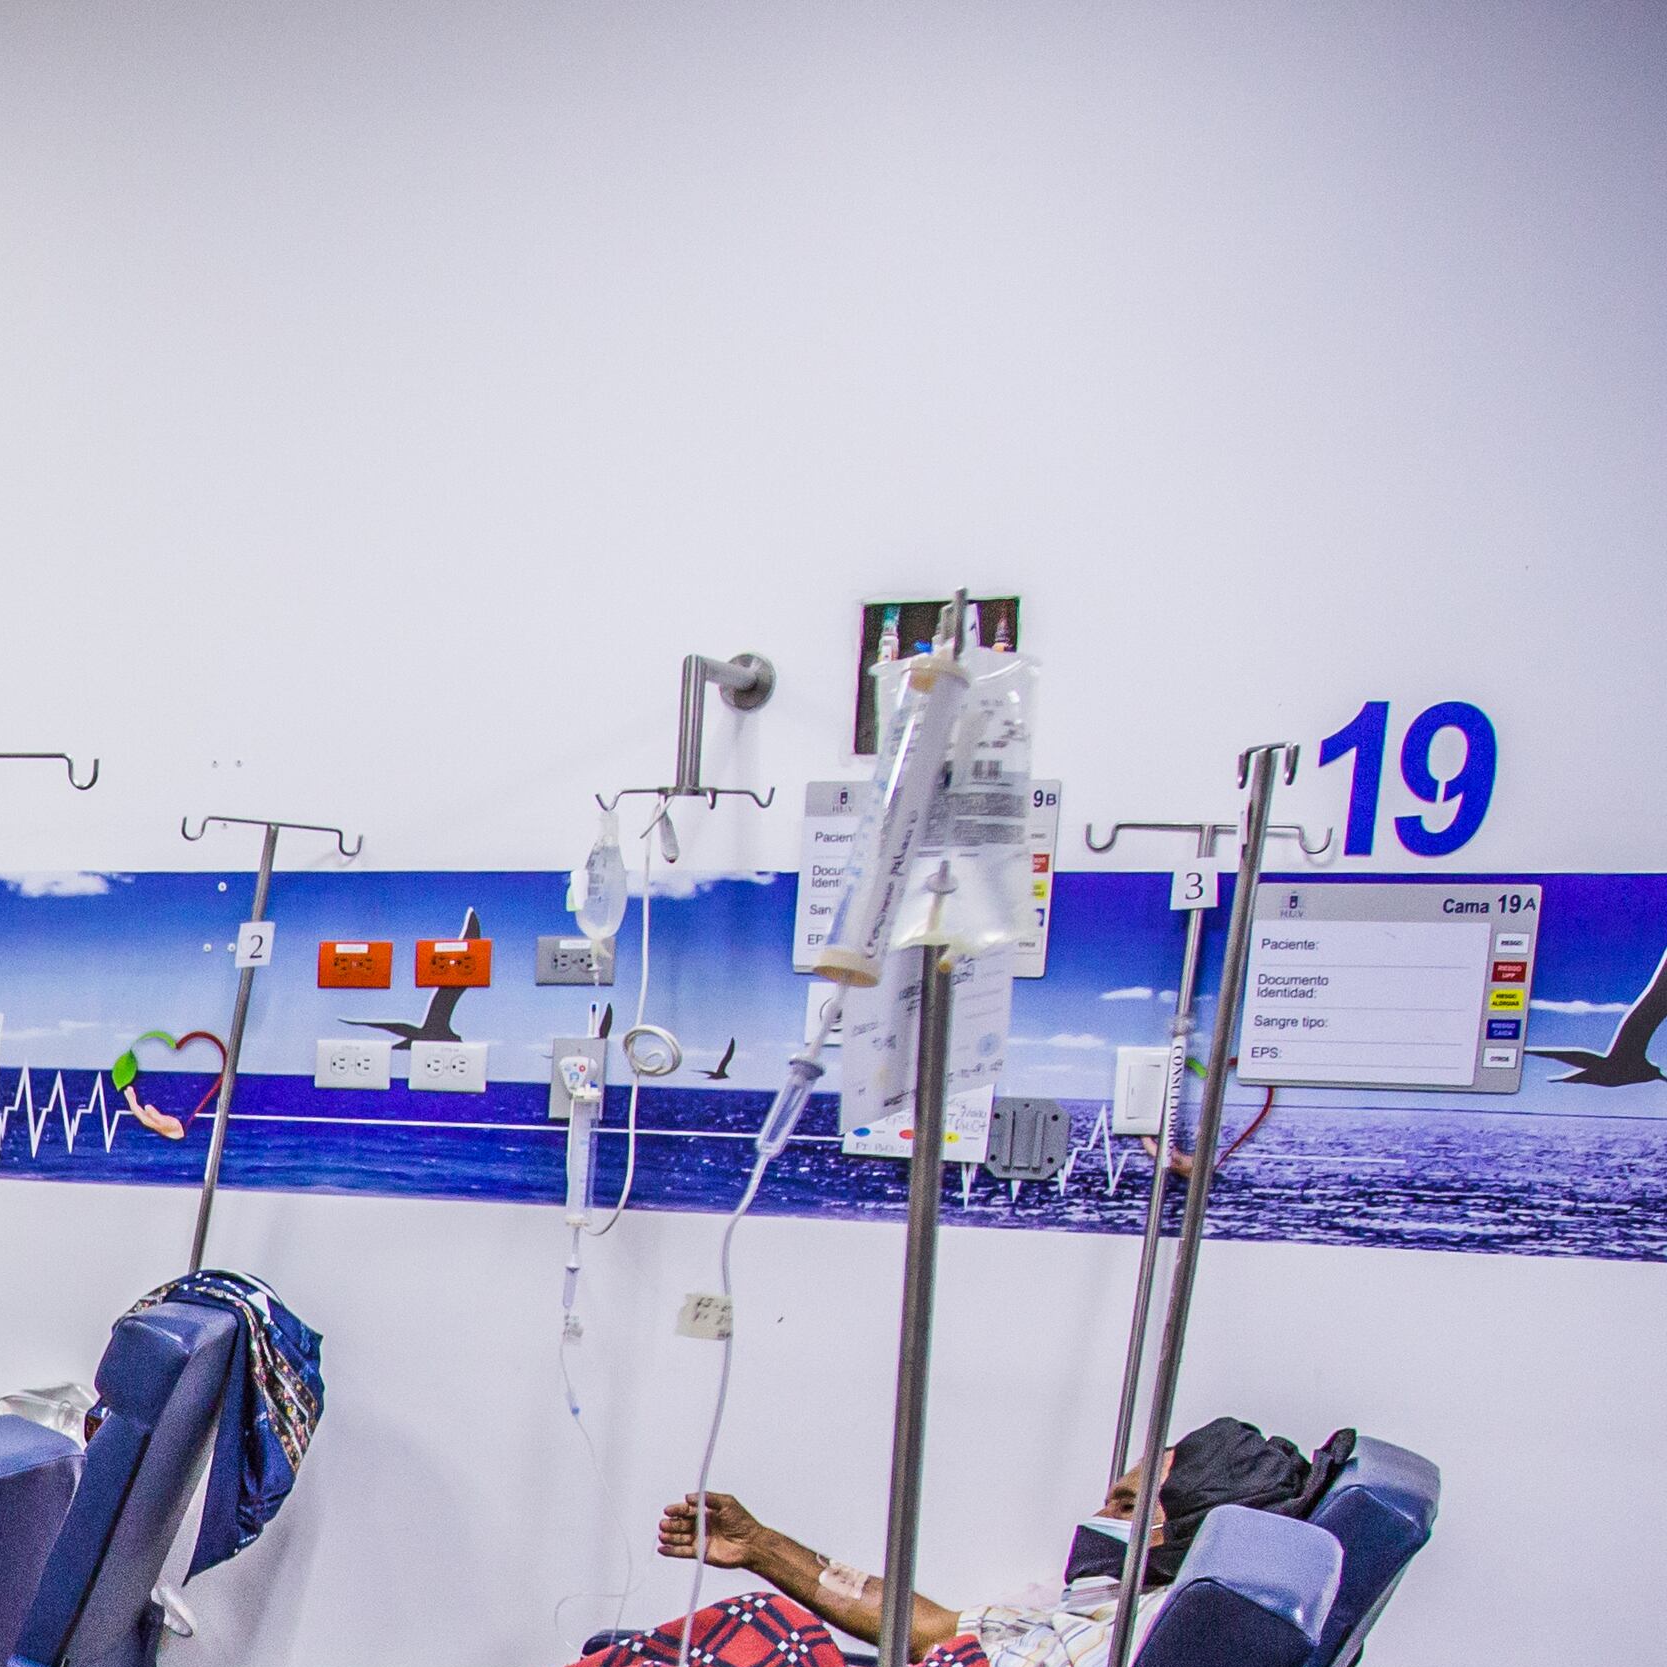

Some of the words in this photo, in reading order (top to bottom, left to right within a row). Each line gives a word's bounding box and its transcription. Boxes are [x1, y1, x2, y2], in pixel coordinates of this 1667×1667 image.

[1318, 700, 1498, 857] 19
[814, 831, 852, 843] Pacien
[1184, 872, 1205, 900] 3
[809, 904, 832, 916] San
[1442, 898, 1490, 914] Cama
[249, 935, 263, 959] 2
[1261, 938, 1319, 950] Paciente:
[1257, 973, 1329, 986] Documento
[1256, 988, 1318, 999] Identidad:
[1254, 1015, 1299, 1029] Sangre
[1302, 1015, 1328, 1030] tipo:
[1251, 1047, 1282, 1059] EPS:
